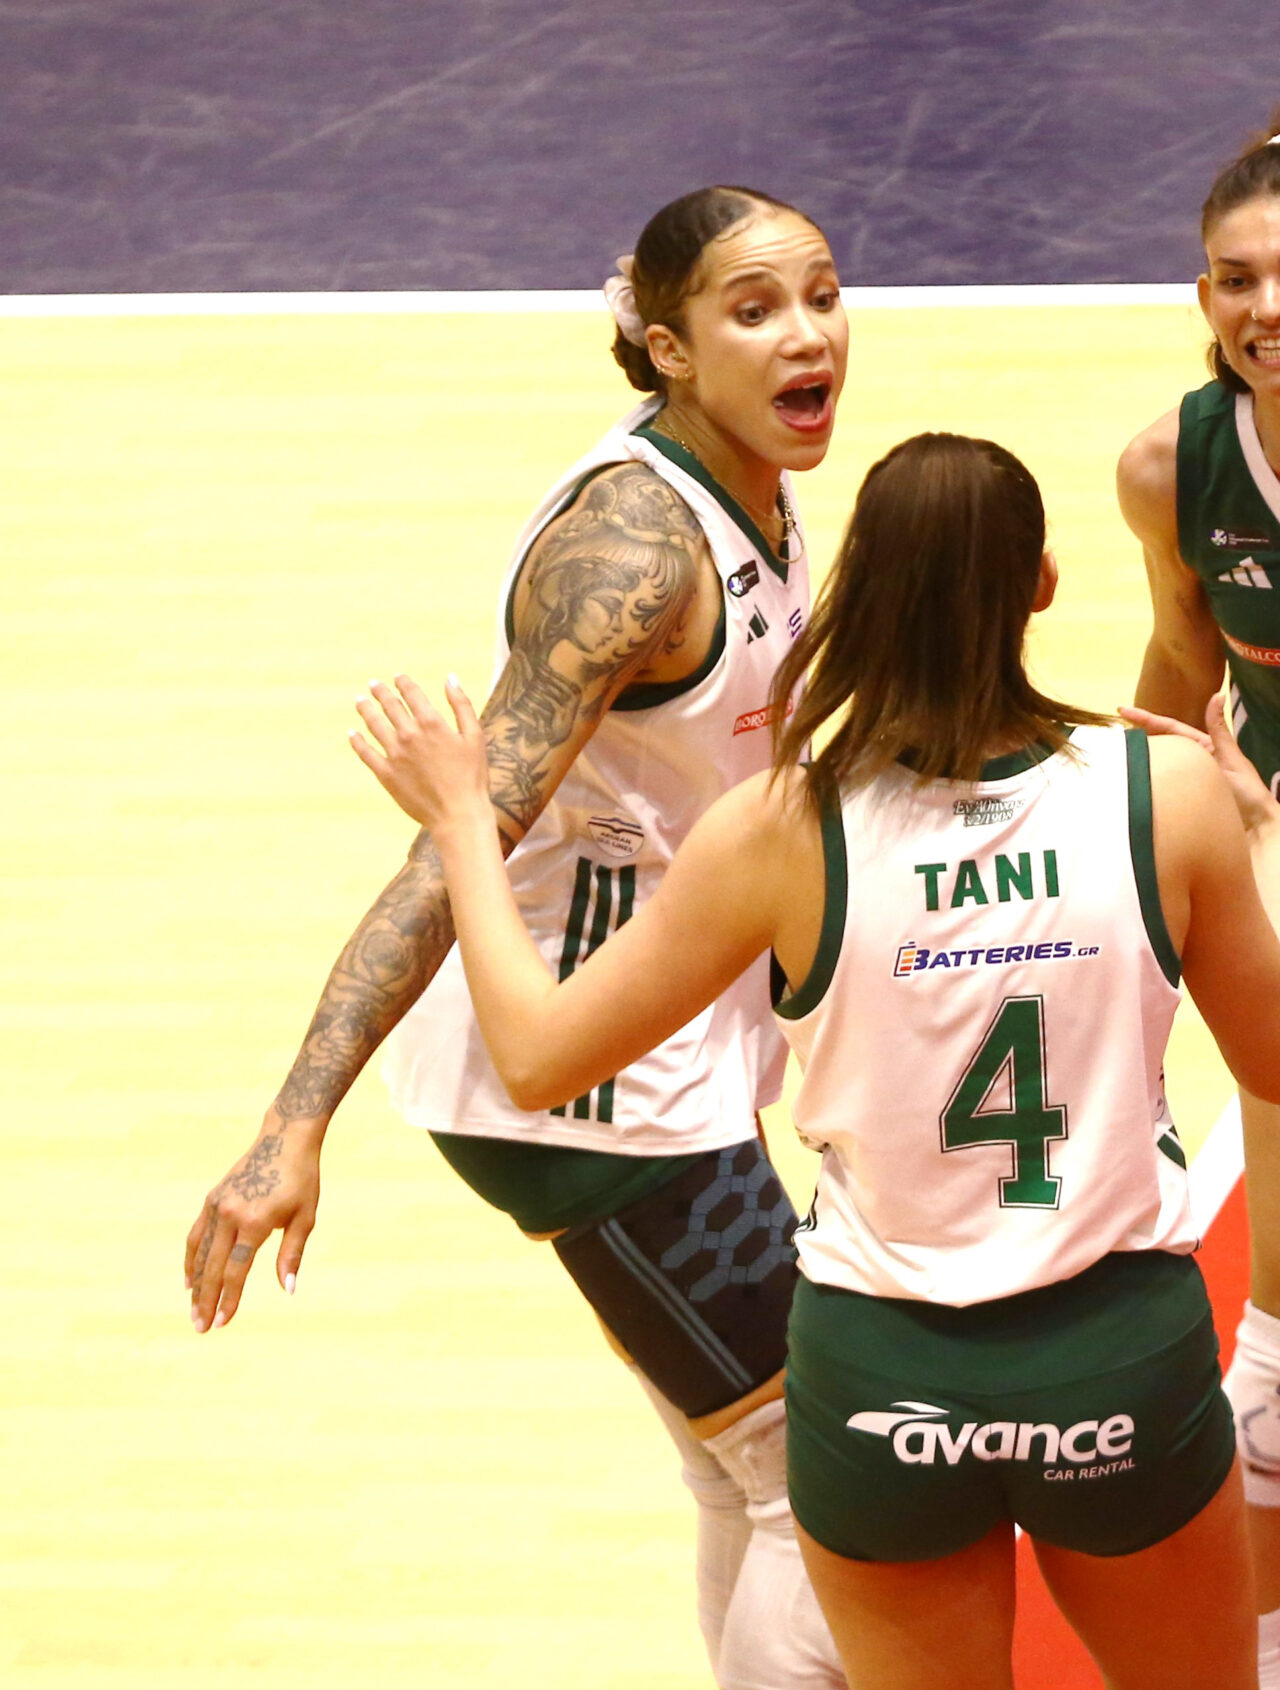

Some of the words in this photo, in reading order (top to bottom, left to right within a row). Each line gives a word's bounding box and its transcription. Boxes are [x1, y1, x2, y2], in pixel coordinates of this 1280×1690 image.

[914, 850, 1060, 911] TANI
[939, 994, 1069, 1210] 4
[893, 1414, 1135, 1465] avance
[1043, 1469, 1075, 1481] CAR
[1078, 1457, 1136, 1480] RENTAL
